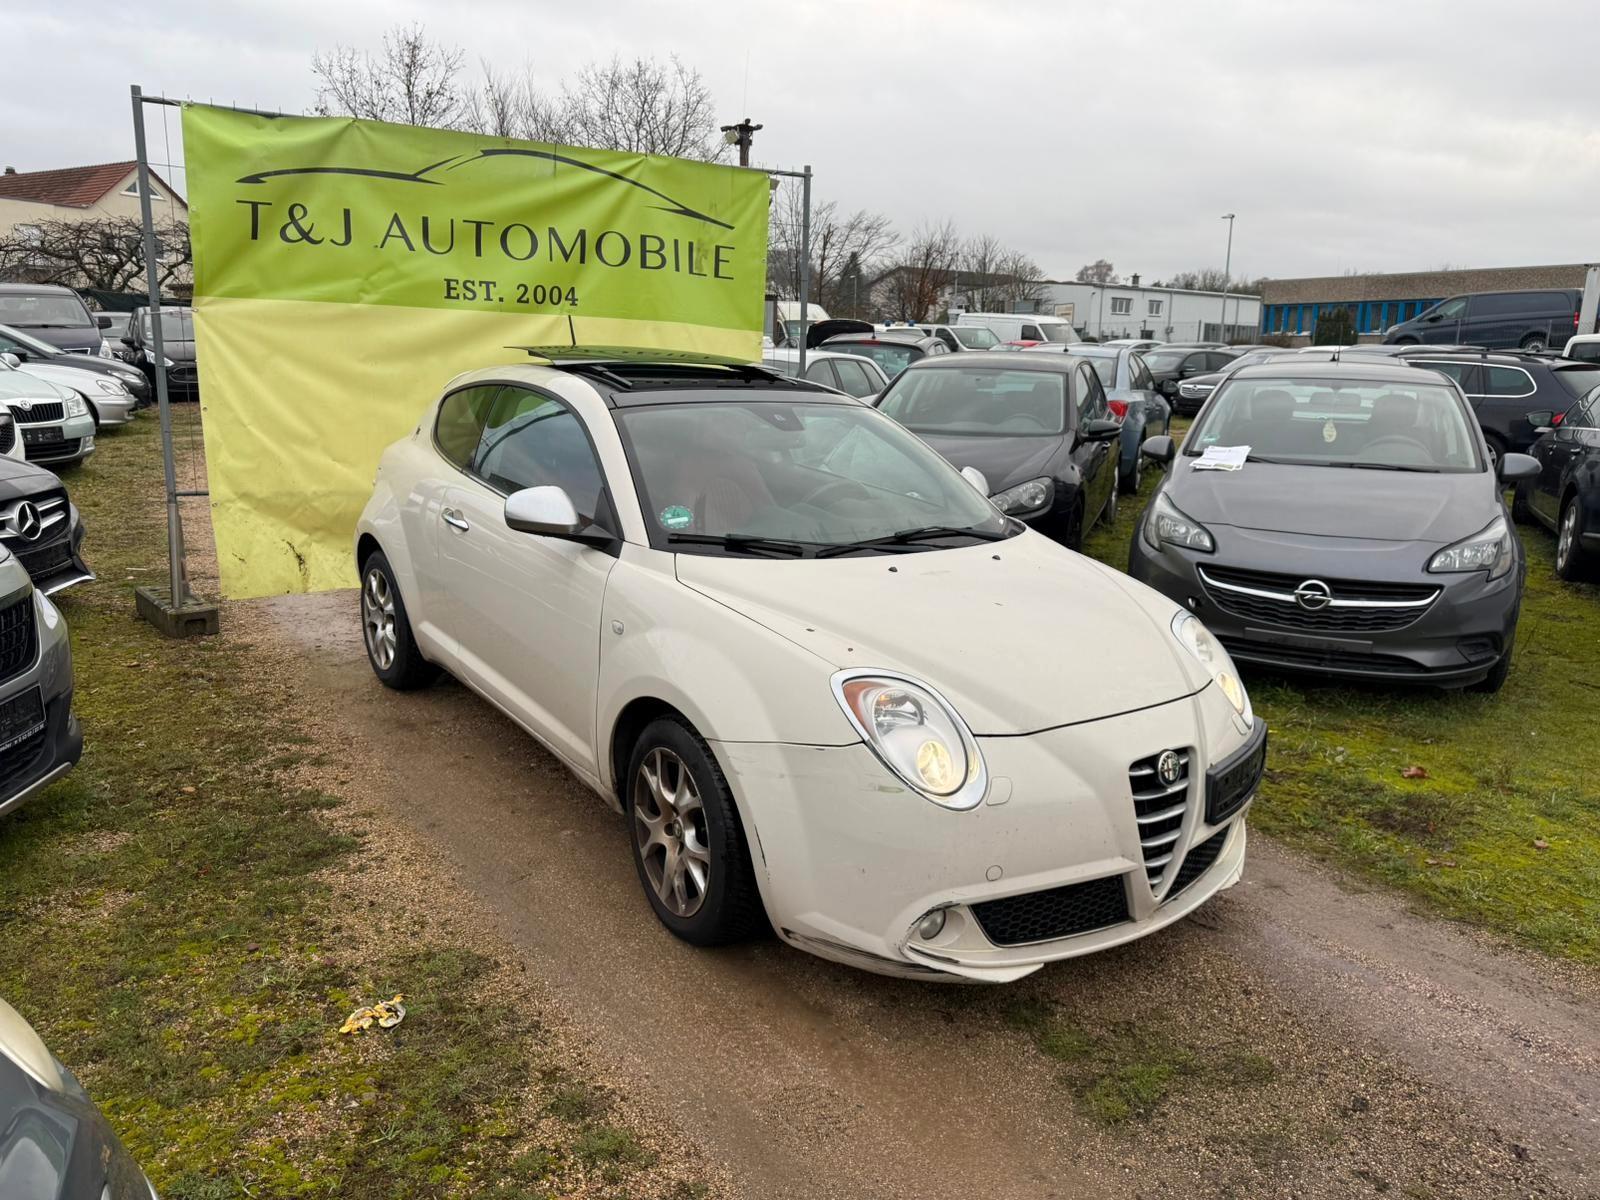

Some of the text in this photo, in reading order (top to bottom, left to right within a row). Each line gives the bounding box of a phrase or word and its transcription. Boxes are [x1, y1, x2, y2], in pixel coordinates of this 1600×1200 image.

[236, 199, 736, 281] T&J AUTOMOBILE
[443, 278, 579, 307] EST. 2004
